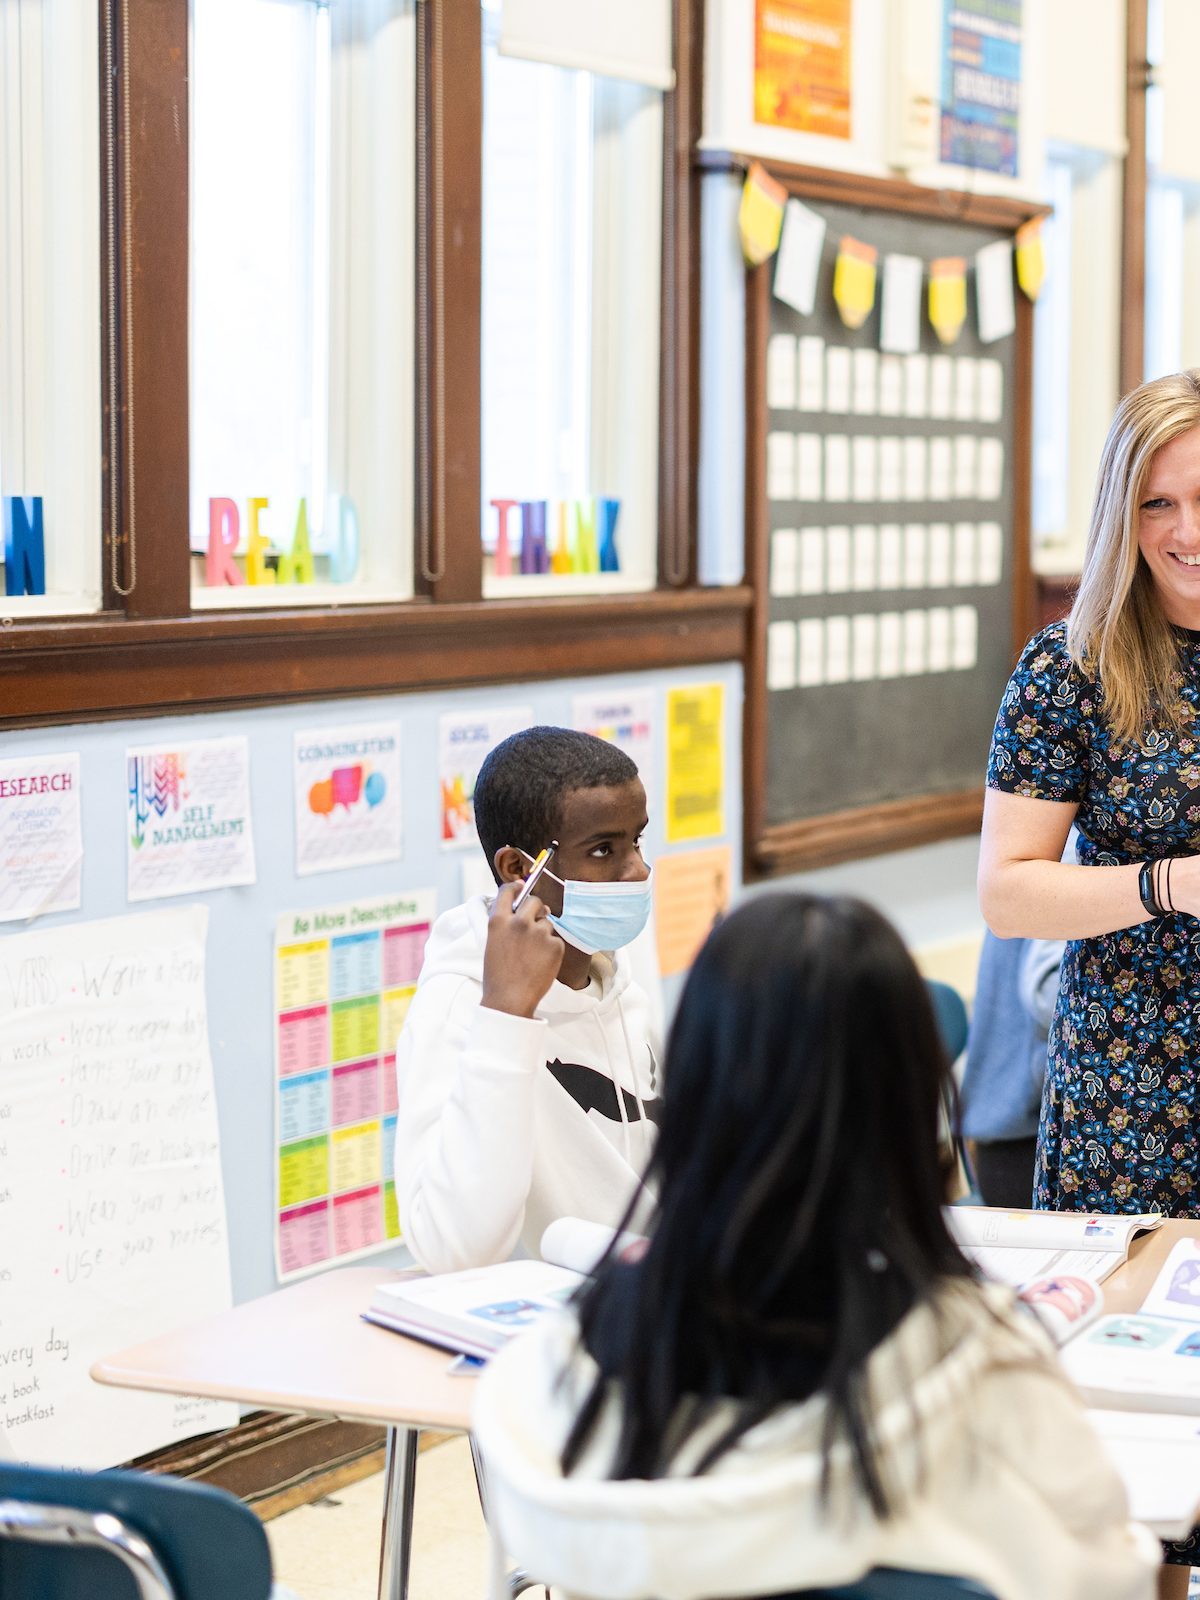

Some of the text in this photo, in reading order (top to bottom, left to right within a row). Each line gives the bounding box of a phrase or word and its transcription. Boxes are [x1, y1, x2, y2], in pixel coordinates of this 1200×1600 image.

[204, 497, 361, 587] READ
[490, 498, 621, 577] THINK
[183, 804, 215, 824] SELF
[152, 817, 245, 847] MANAGEMENT
[293, 916, 309, 936] Be
[314, 911, 346, 931] More
[12, 1038, 52, 1060] work
[45, 1326, 70, 1362] day
[13, 1374, 41, 1400] book
[6, 1402, 55, 1429] breakfast
